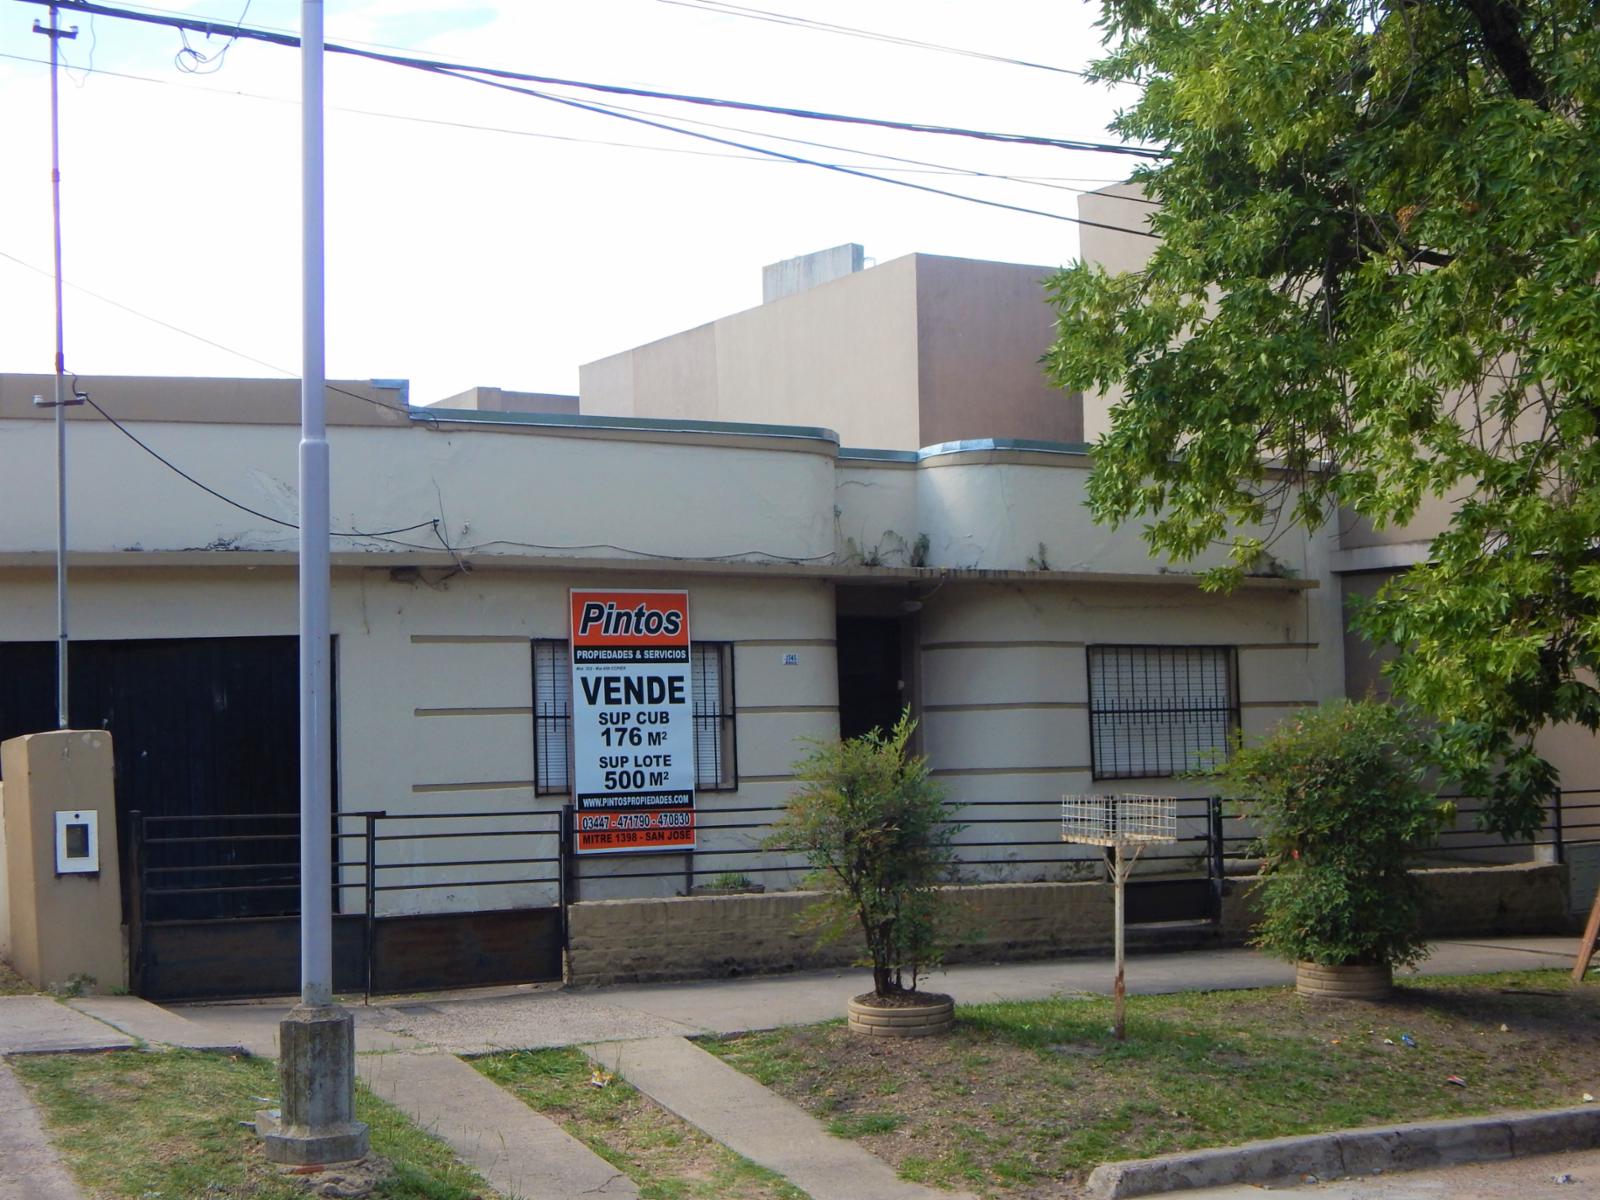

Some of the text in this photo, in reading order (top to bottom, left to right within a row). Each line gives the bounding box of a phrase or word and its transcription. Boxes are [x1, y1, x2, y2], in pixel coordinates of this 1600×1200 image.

[579, 602, 682, 636] Pintos
[576, 649, 687, 659] PROPIEDADES & SERVICIOS
[581, 676, 686, 705] VENDE
[598, 711, 670, 725] SUP CUB
[601, 727, 642, 746] 176
[599, 755, 672, 768] SUP LOTE
[604, 770, 645, 790] 500
[583, 795, 689, 807] WWW.PINTOSPROPIEDADES.COM
[582, 816, 609, 830] 03447
[616, 814, 651, 829] 471790
[657, 812, 690, 828] 470830
[583, 834, 613, 844] MITRE
[616, 833, 637, 842] 1398
[645, 832, 665, 841] SAN
[667, 830, 691, 840] JOSE
